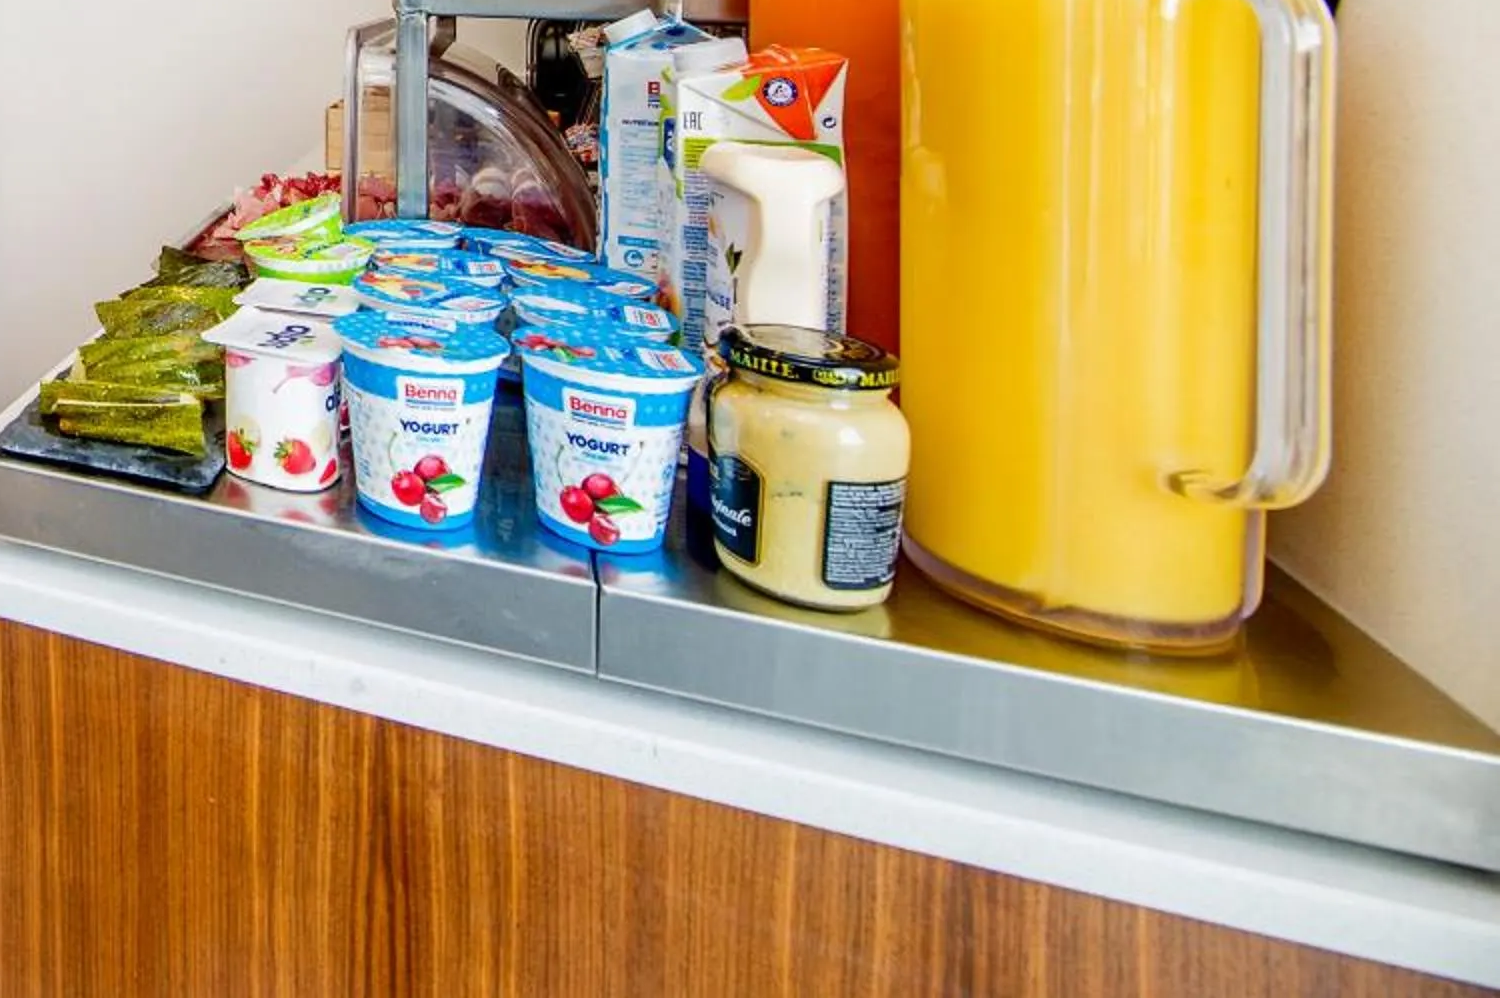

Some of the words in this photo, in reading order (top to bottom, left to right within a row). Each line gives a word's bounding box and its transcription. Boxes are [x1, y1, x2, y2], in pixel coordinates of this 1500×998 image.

[405, 383, 457, 401] Benna
[569, 395, 628, 419] Benna
[400, 418, 459, 435] YOGURT
[566, 432, 631, 457] YOGURT
